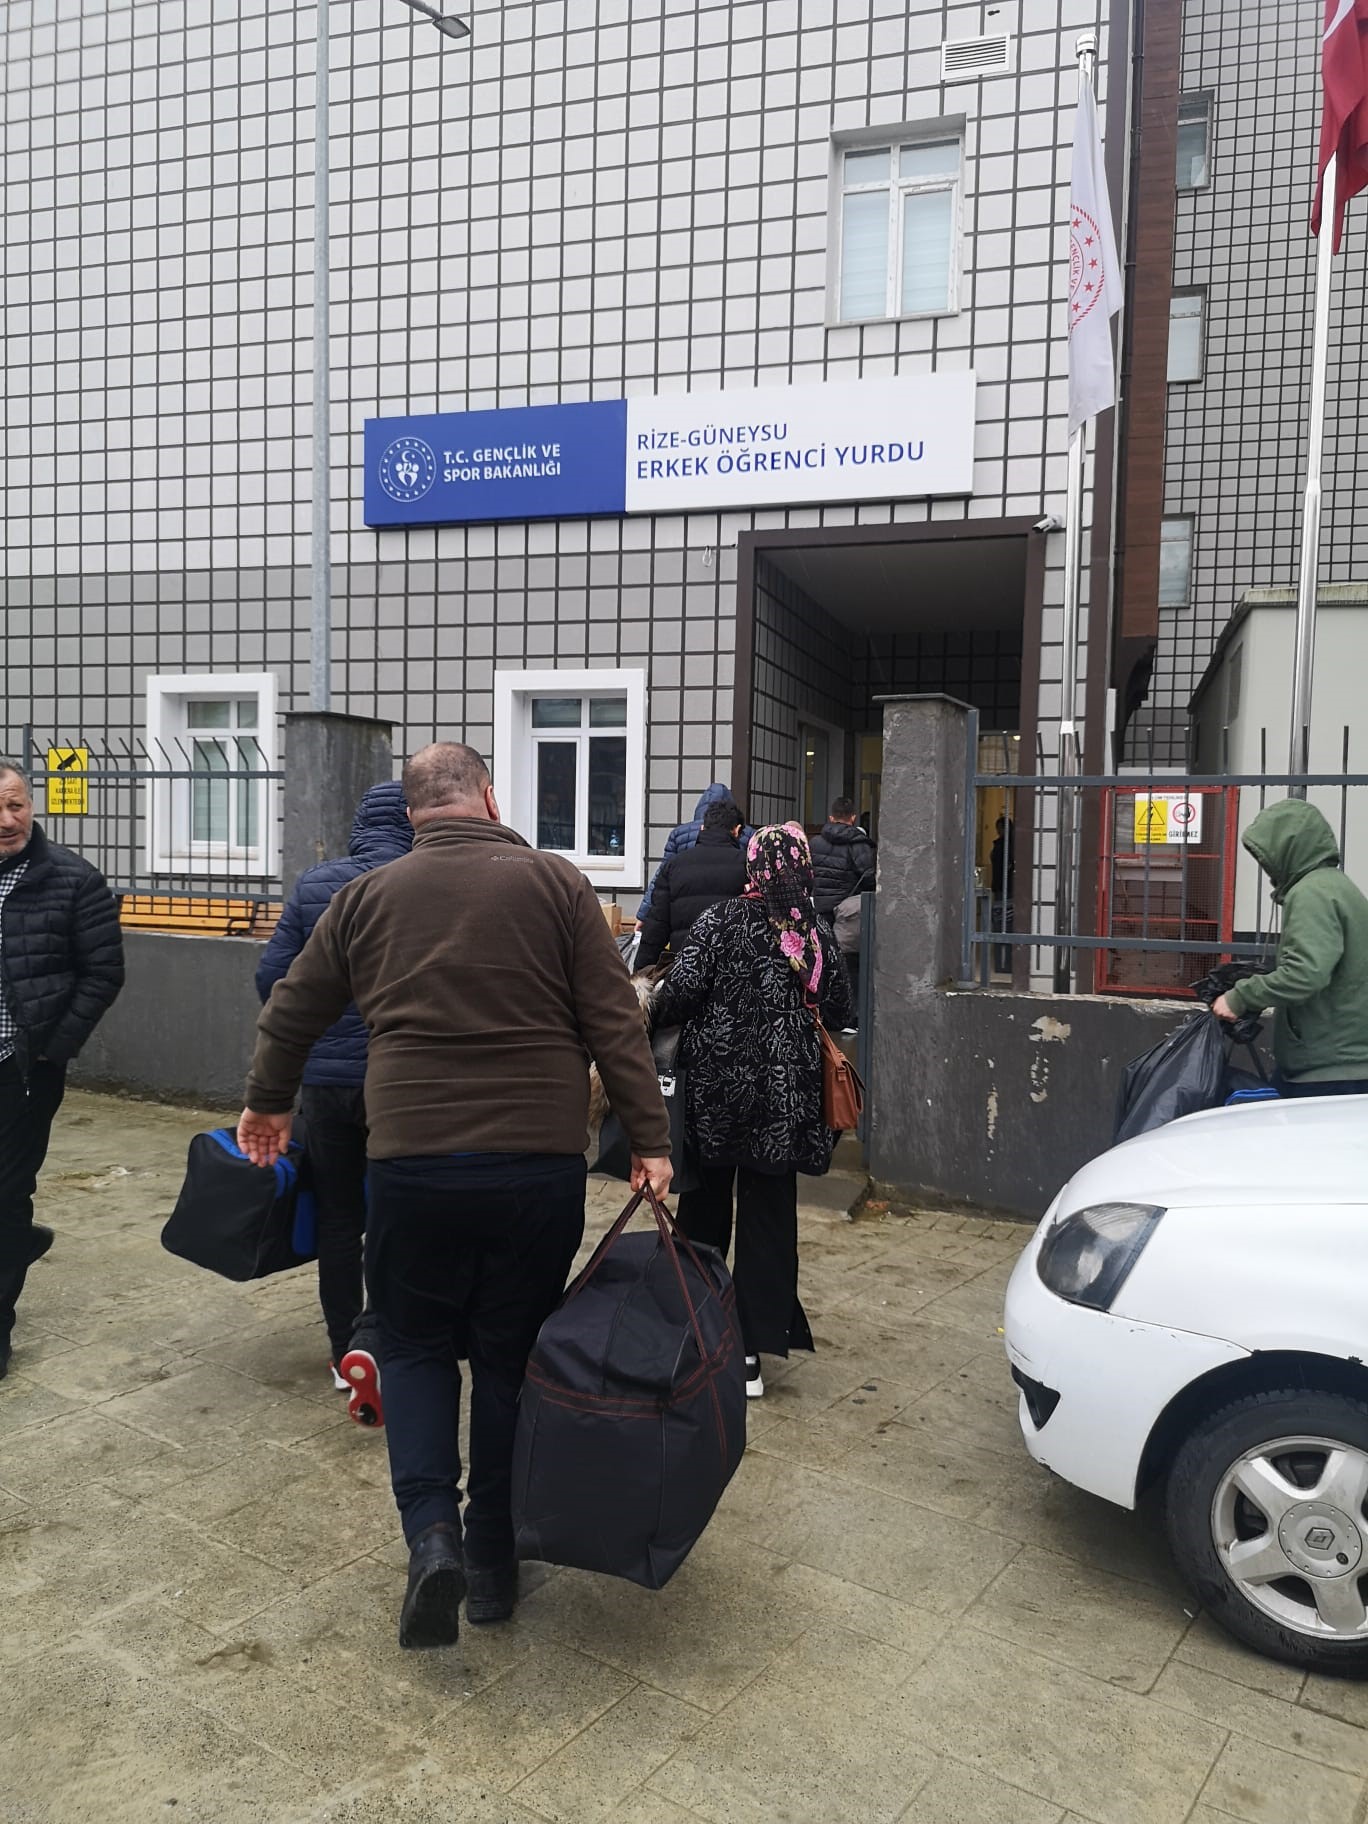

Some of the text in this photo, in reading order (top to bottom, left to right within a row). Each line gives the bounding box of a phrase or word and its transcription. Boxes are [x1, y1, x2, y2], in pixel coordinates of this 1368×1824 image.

[637, 423, 788, 450] RİZE-GÜNEYSU
[444, 443, 561, 464] T.C. GENÇLİK VE
[637, 441, 924, 480] ERKEK ÖĞRENCİ YURDU
[443, 461, 561, 483] SPOR BAKANLIĞI
